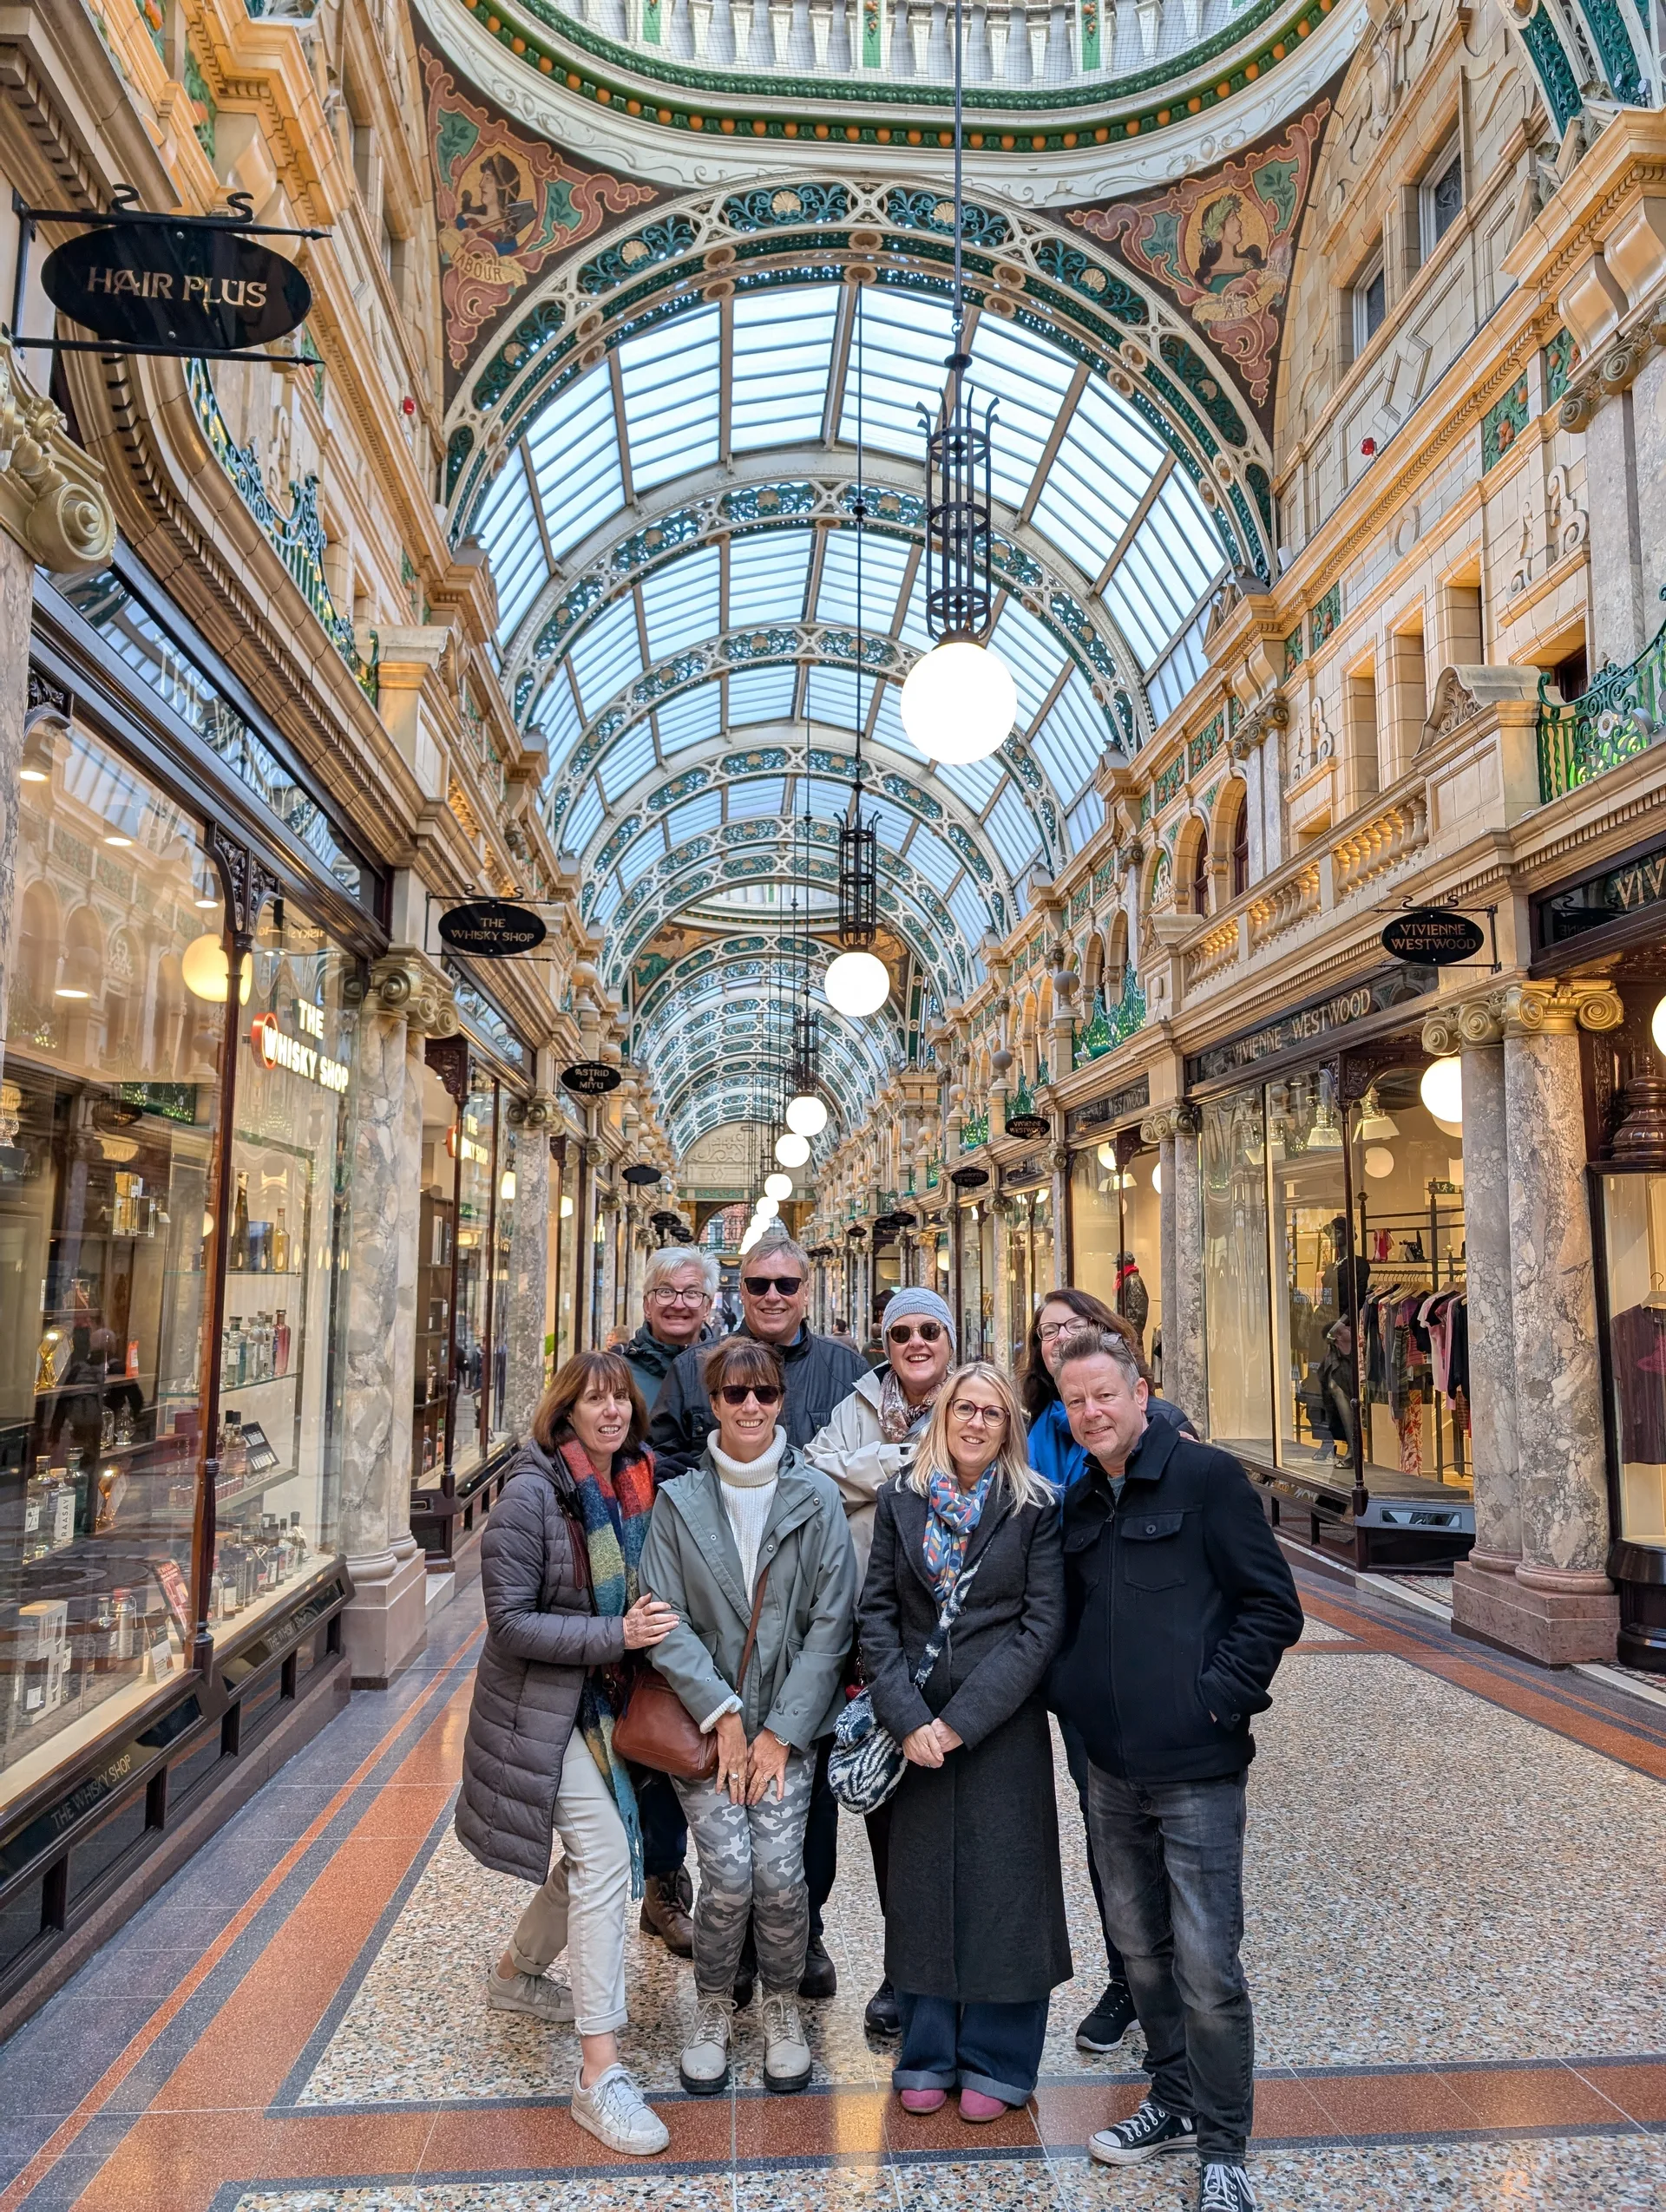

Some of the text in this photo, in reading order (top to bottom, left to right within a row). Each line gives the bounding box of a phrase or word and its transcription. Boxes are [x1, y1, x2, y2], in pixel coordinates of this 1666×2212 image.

[452, 246, 502, 282] LABOUR
[88, 267, 267, 307] HAIR PLUS
[450, 929, 535, 943] WHISKY SHOP
[480, 917, 506, 928] THE
[1400, 924, 1466, 936] VIVIENNE
[1390, 939, 1476, 951] WESTWOOD
[298, 998, 325, 1040] THE
[1232, 988, 1371, 1066] VIVIENNE WESTWOOD
[264, 1025, 350, 1094] WHISKY SHOP
[574, 1068, 610, 1077] ASTRID
[579, 1081, 604, 1090] MIYU
[61, 1498, 69, 1537] RAASAY
[50, 1754, 131, 1829] THE WHISKY SHOP
